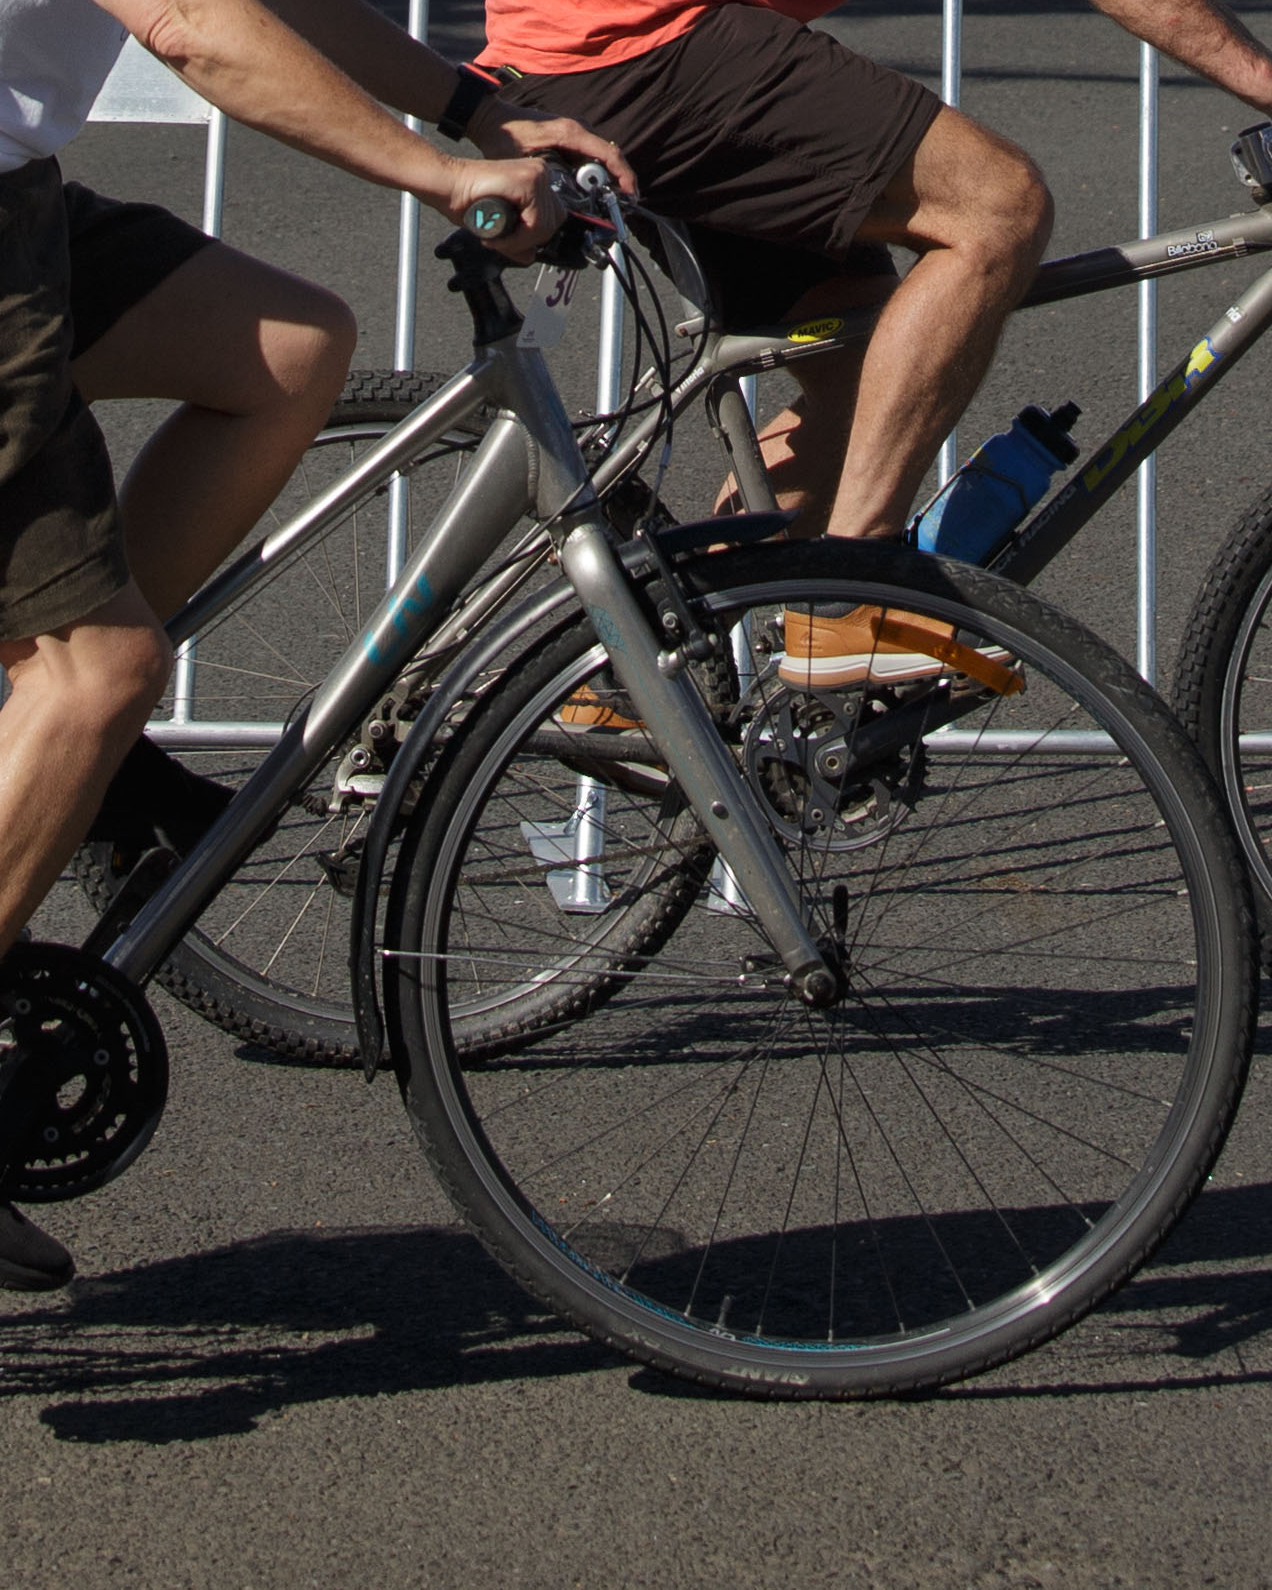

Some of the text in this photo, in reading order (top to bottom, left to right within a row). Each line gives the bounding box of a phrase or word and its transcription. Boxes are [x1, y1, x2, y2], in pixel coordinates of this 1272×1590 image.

[798, 322, 835, 338] MAVIC
[1019, 484, 1077, 549] RACING
[722, 1366, 810, 1386] GIANT
